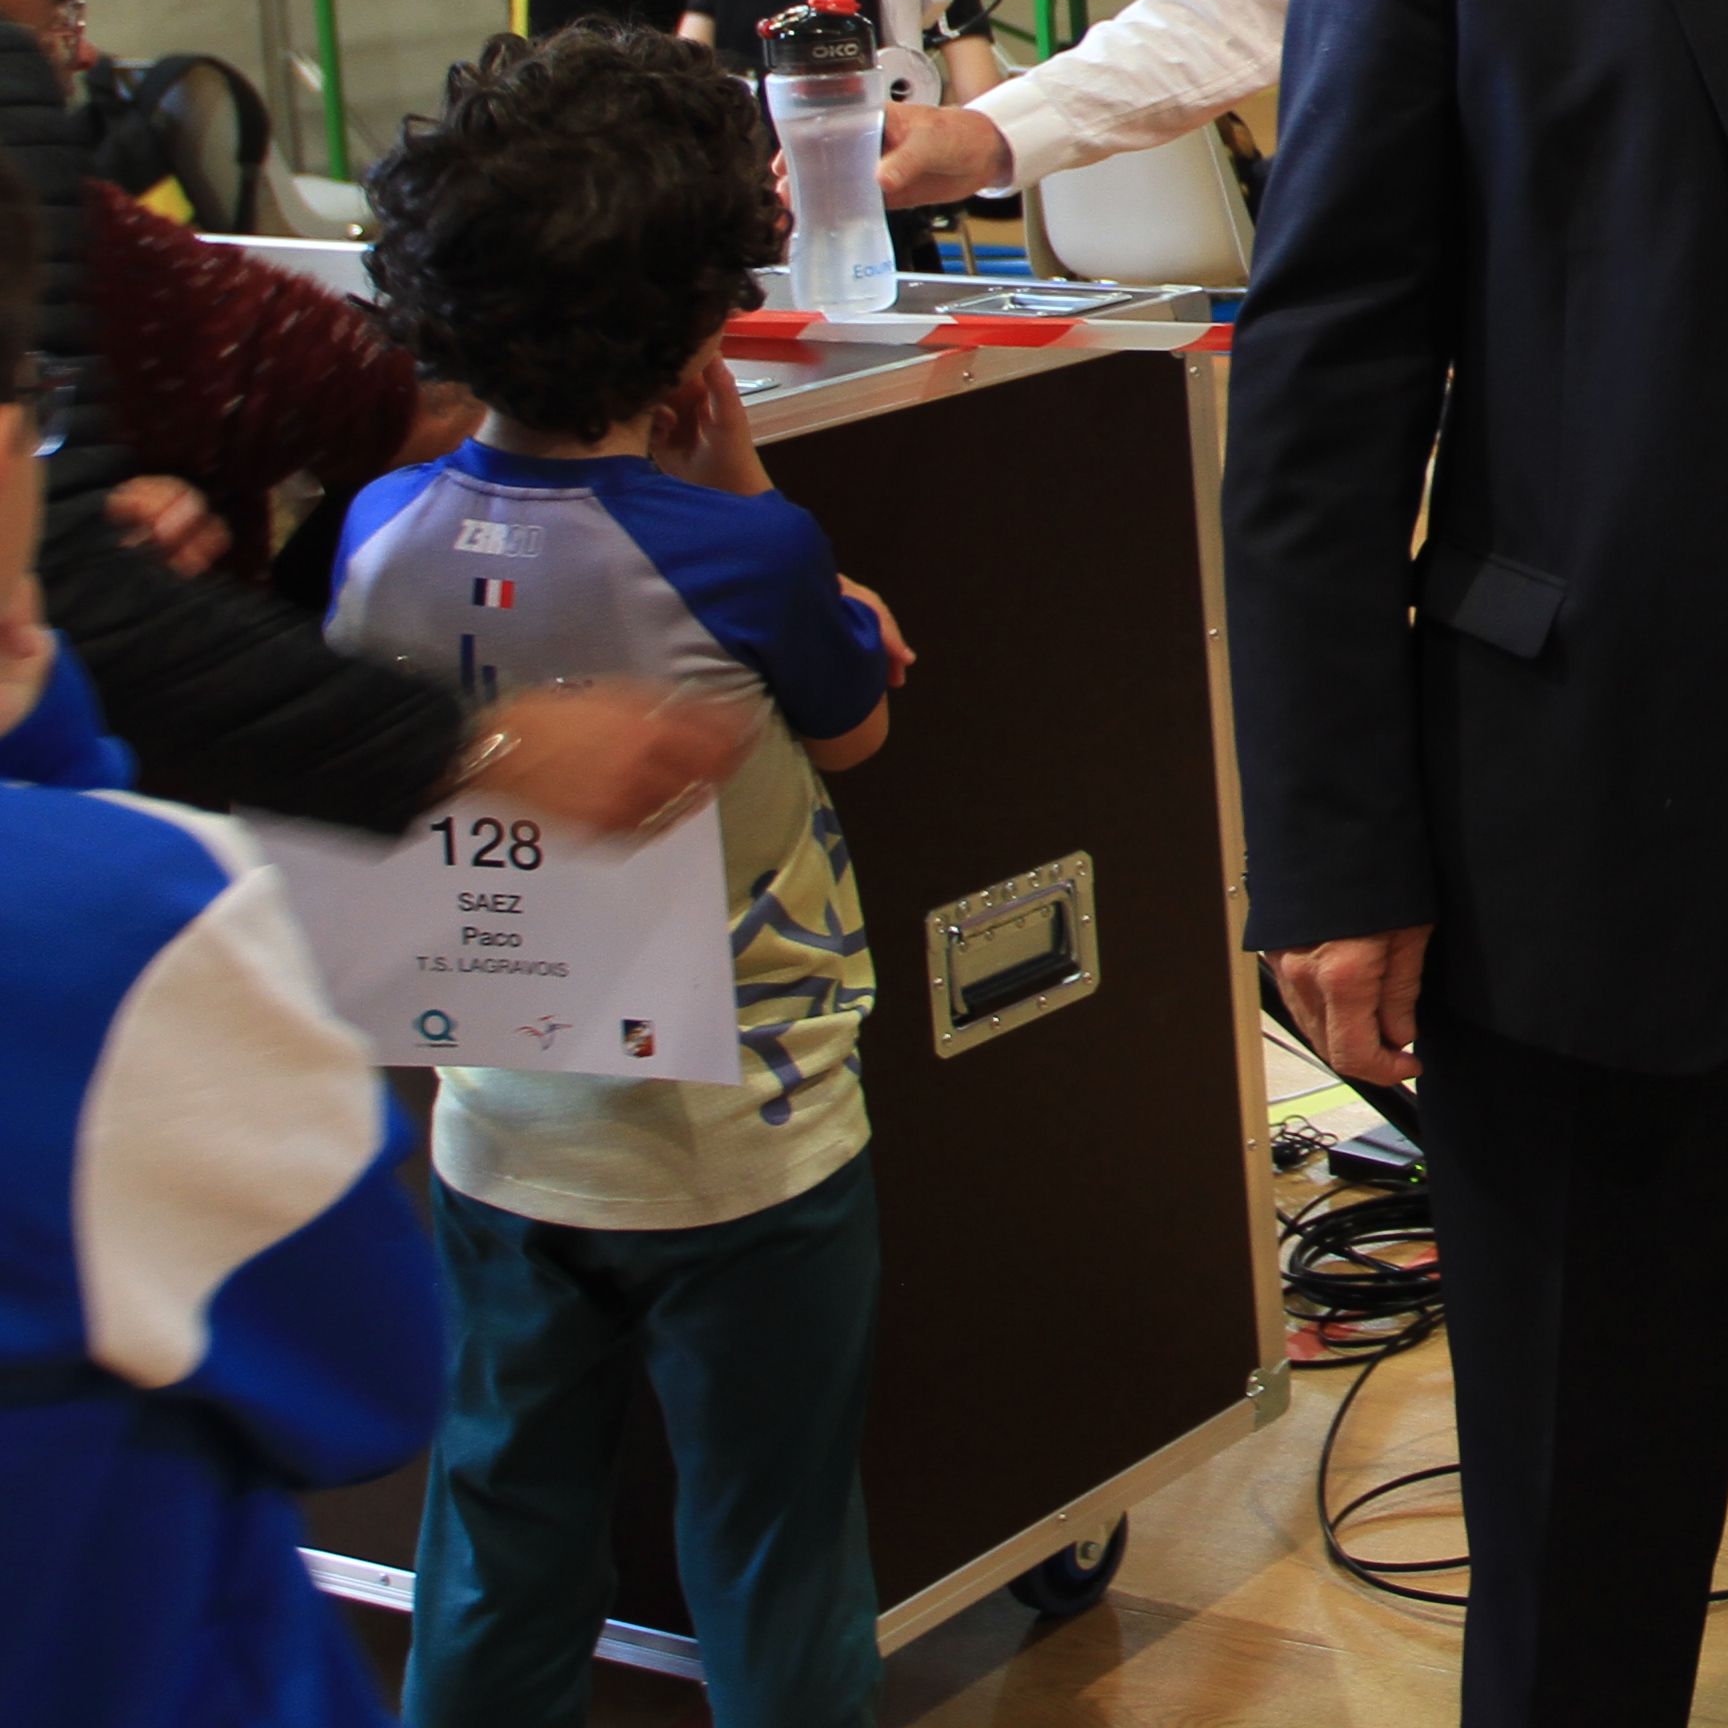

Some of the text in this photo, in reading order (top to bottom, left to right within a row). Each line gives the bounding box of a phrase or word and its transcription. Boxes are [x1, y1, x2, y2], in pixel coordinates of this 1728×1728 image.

[431, 816, 544, 871] 128
[457, 892, 523, 914] SAEZ
[461, 926, 523, 948] Paco
[417, 956, 570, 979] T.S. LAGRAVOIS
